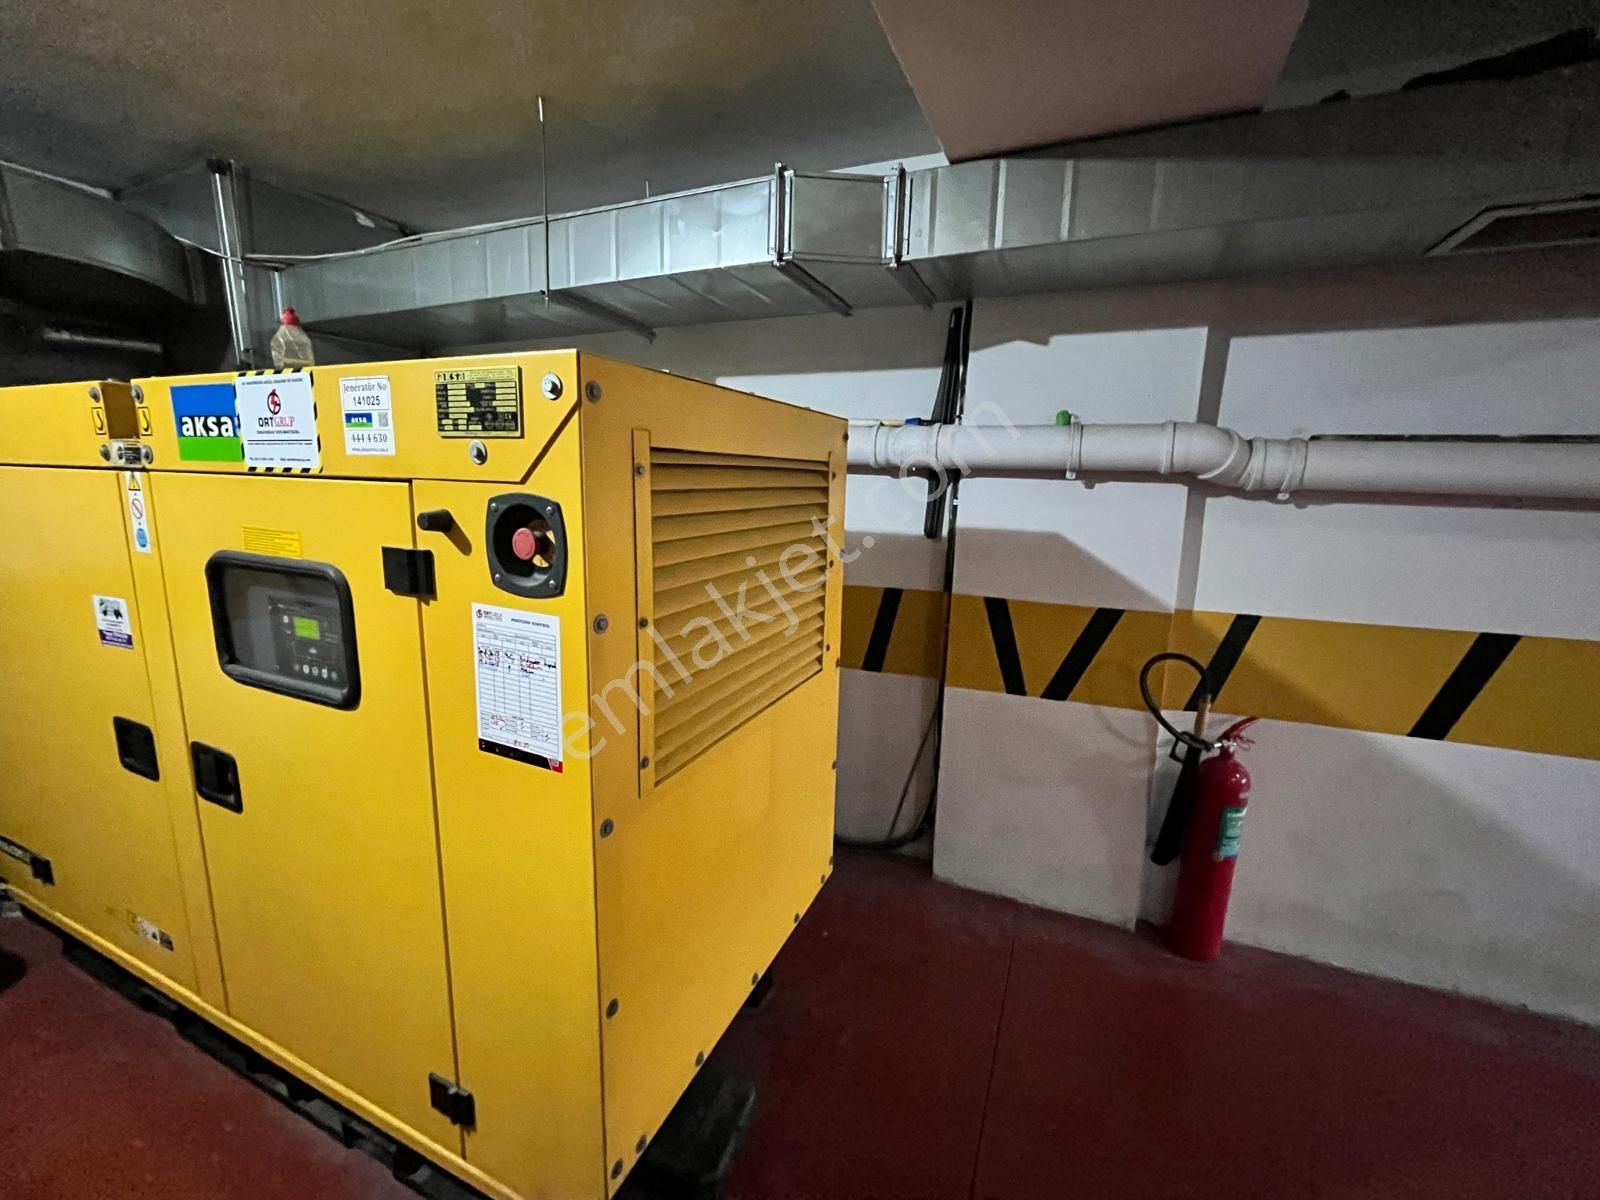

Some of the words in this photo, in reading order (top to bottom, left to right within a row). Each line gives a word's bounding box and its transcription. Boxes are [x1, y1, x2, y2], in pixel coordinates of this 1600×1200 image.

[343, 383, 376, 394] Jeneratör
[377, 382, 387, 391] No
[352, 395, 381, 406] 141025
[181, 416, 234, 437] aksa
[351, 433, 365, 443] 444
[367, 433, 372, 443] 4
[373, 433, 388, 443] 630
